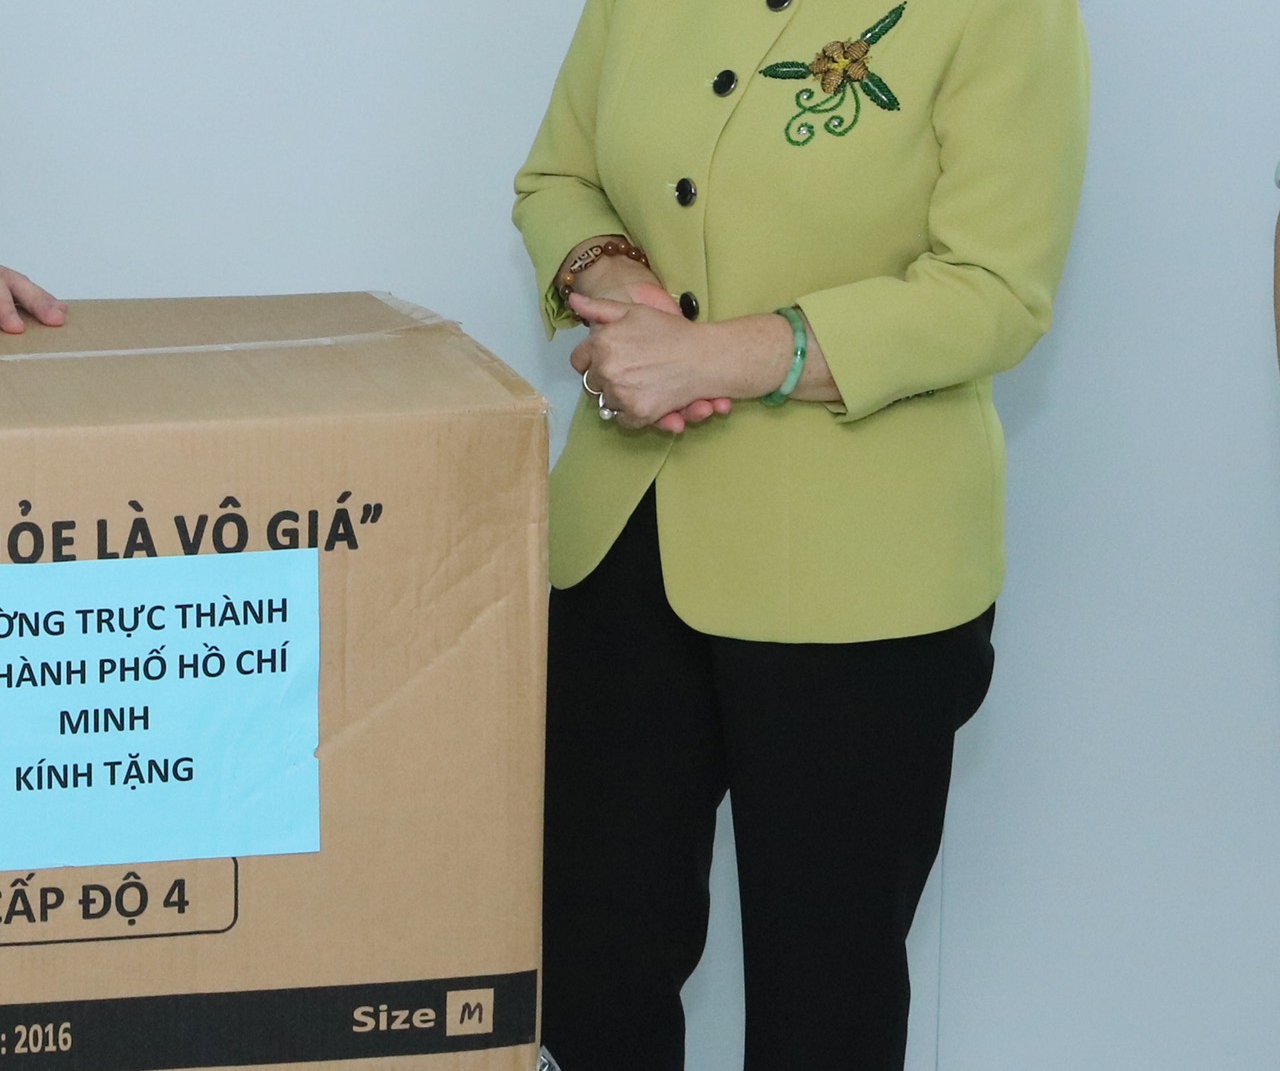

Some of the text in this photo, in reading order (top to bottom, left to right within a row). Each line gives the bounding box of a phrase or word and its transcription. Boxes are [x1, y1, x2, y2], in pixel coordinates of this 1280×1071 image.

[97, 500, 158, 560] LÀ
[174, 495, 249, 555] VÔ
[75, 604, 166, 638] TRỰC
[175, 594, 288, 629] THÀNH
[99, 644, 167, 683] PHỐ
[178, 642, 226, 679] HỒ
[236, 641, 290, 675] CHÍ
[60, 706, 149, 735] MINH
[16, 752, 194, 791] KÍNH TẶNG
[79, 871, 148, 926] ĐỘ
[163, 879, 189, 914] 4
[352, 1001, 484, 1033] Size M
[14, 1022, 72, 1054] 2016
